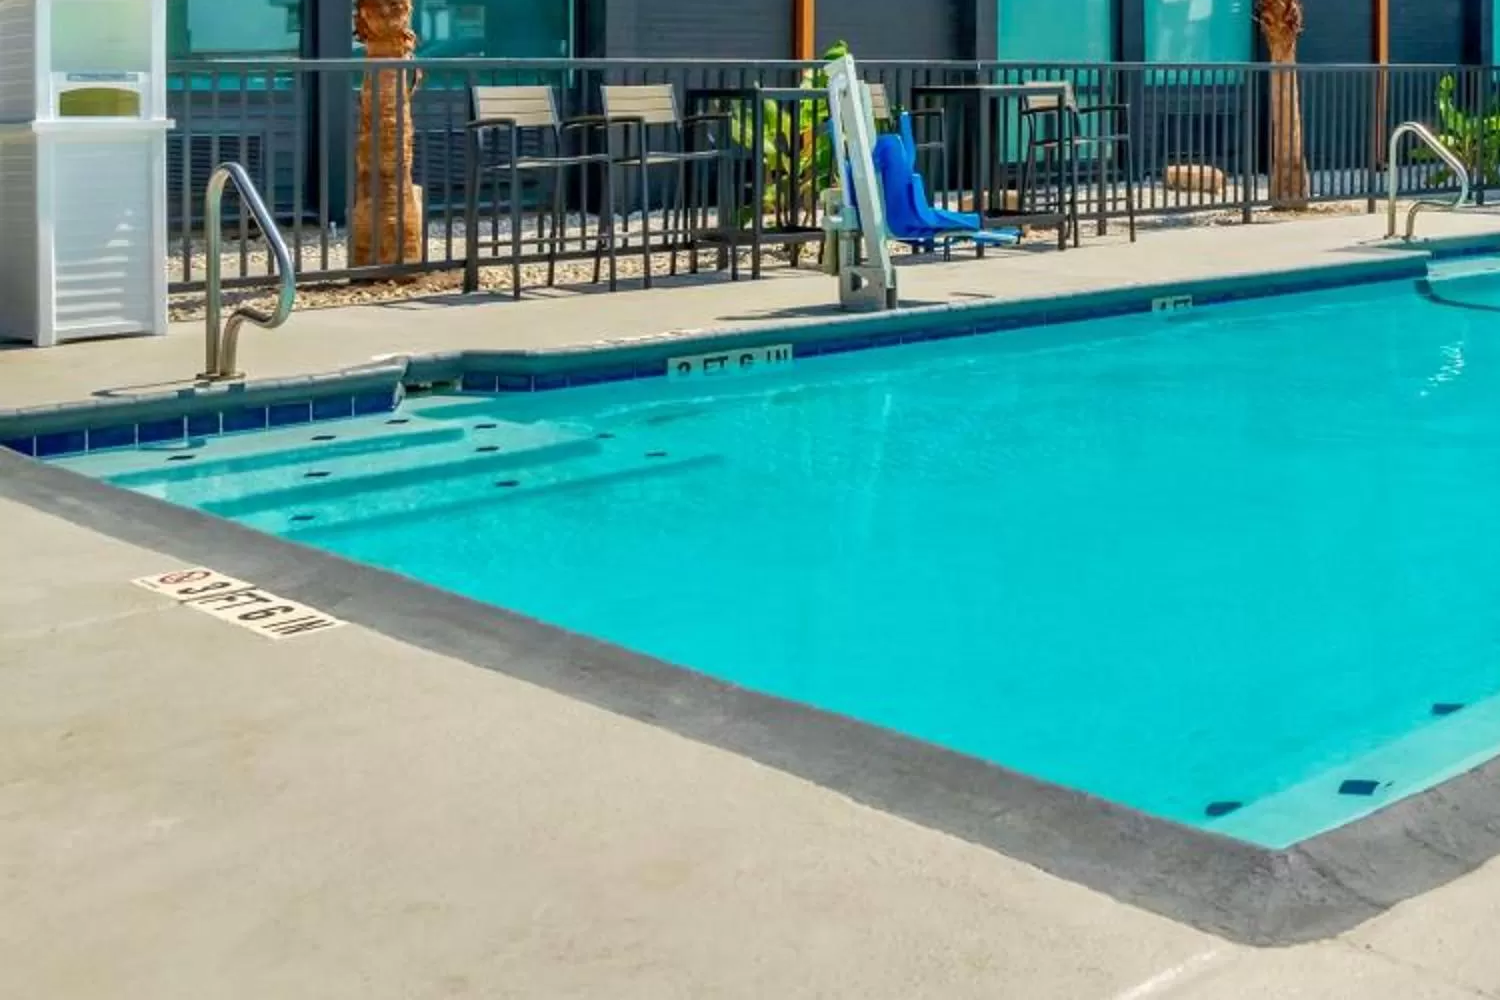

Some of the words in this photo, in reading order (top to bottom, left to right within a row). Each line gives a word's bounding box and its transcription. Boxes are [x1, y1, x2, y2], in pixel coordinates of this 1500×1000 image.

[703, 355, 729, 376] FT
[766, 348, 788, 364] IN
[176, 581, 233, 596] 3
[197, 591, 273, 611] FT
[237, 605, 296, 621] 6
[262, 615, 336, 635] IN
